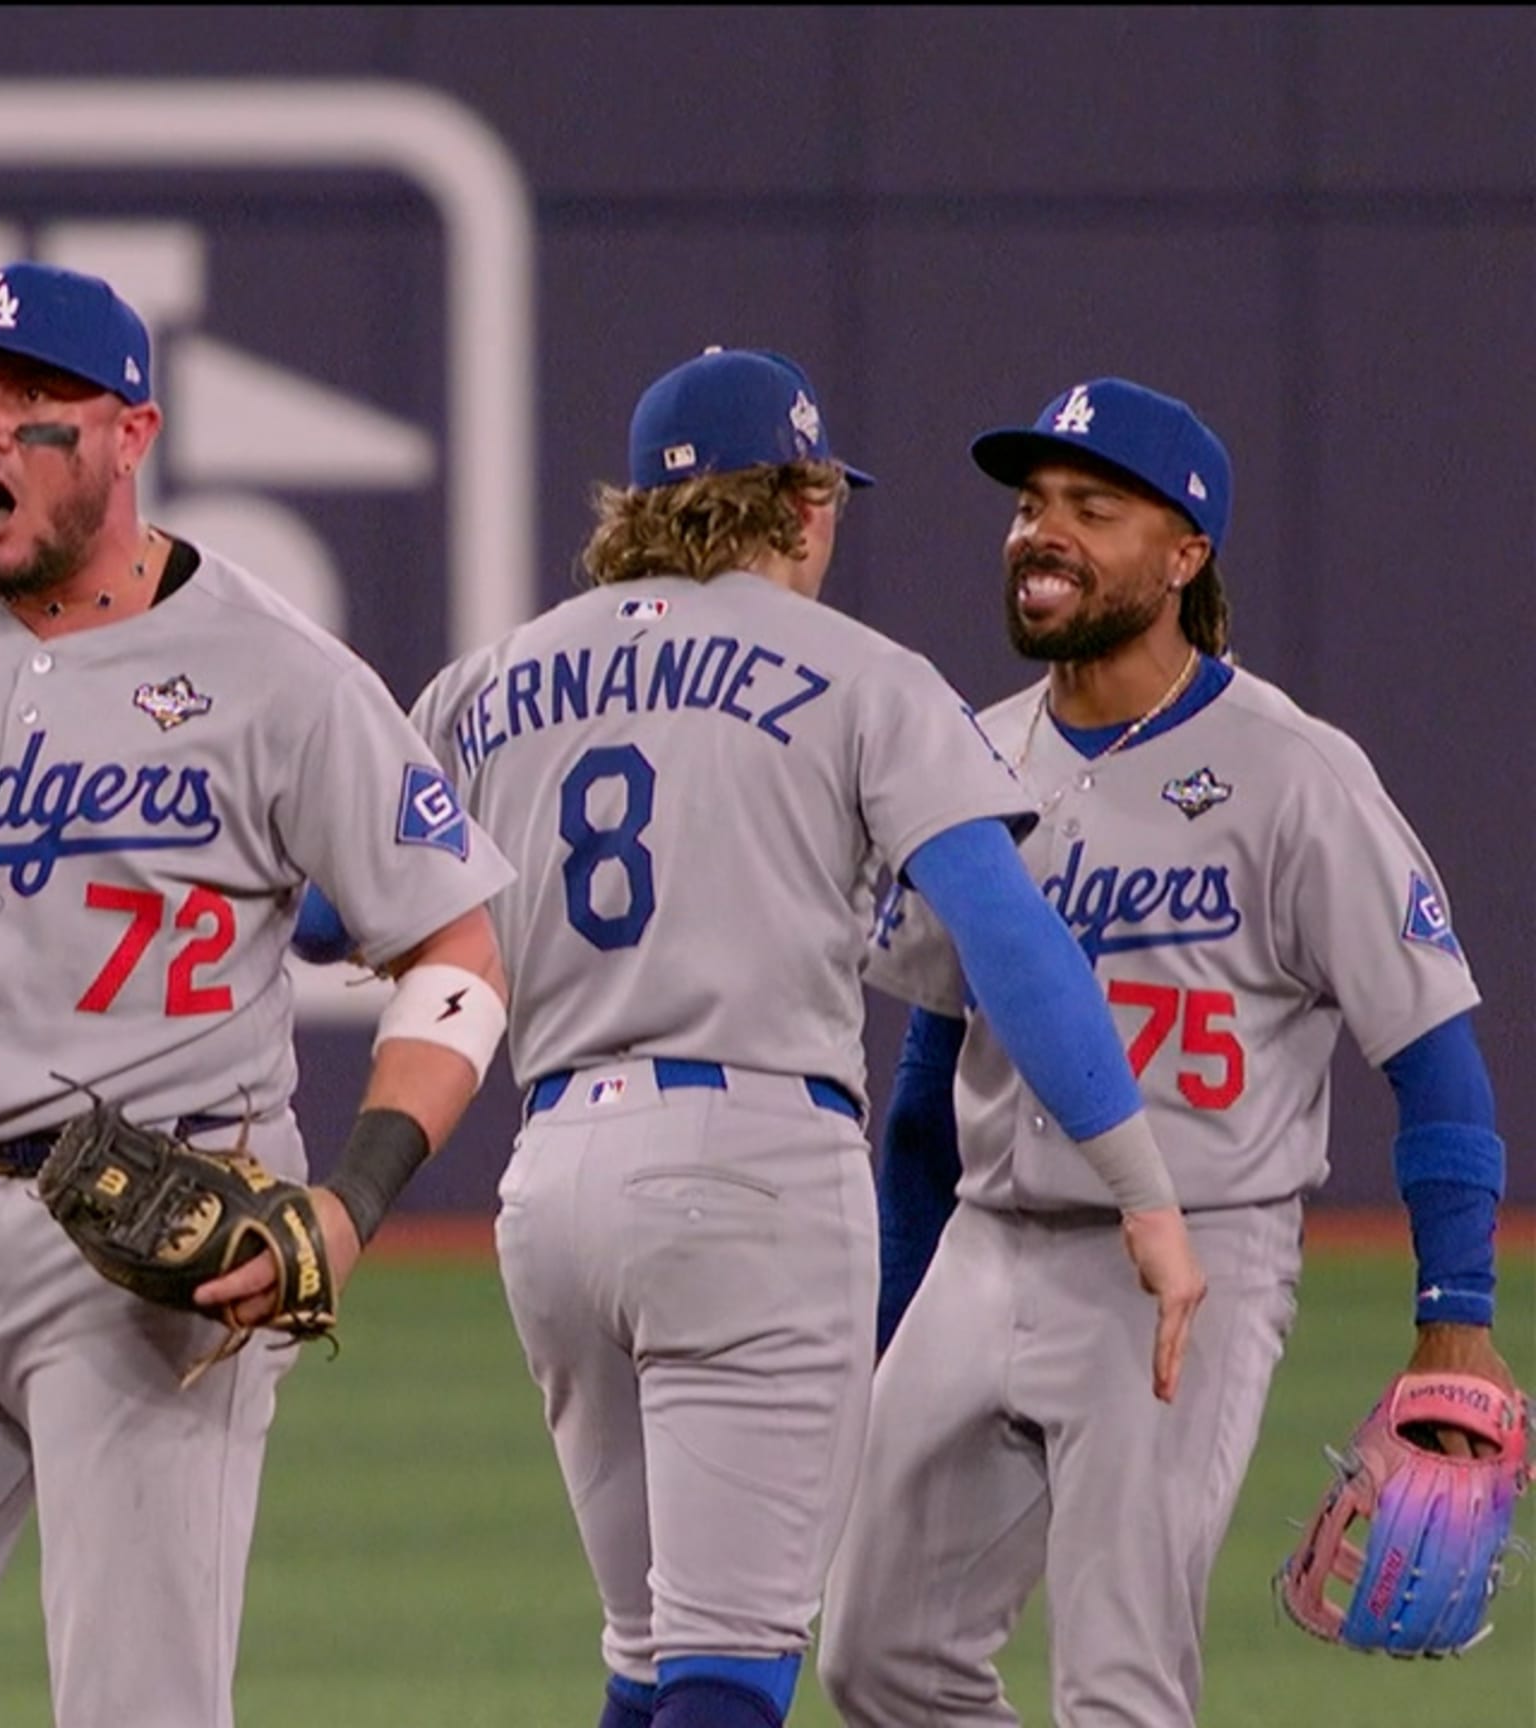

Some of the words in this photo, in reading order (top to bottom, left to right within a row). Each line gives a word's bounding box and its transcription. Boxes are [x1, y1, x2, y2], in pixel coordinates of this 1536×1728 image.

[1053, 384, 1095, 434] LA
[455, 629, 831, 780] HERNÁNDEZ
[413, 781, 454, 826] G
[559, 742, 657, 952] 8
[74, 880, 237, 1018] 72
[1042, 838, 1241, 971] dgers
[1107, 978, 1245, 1111] 75
